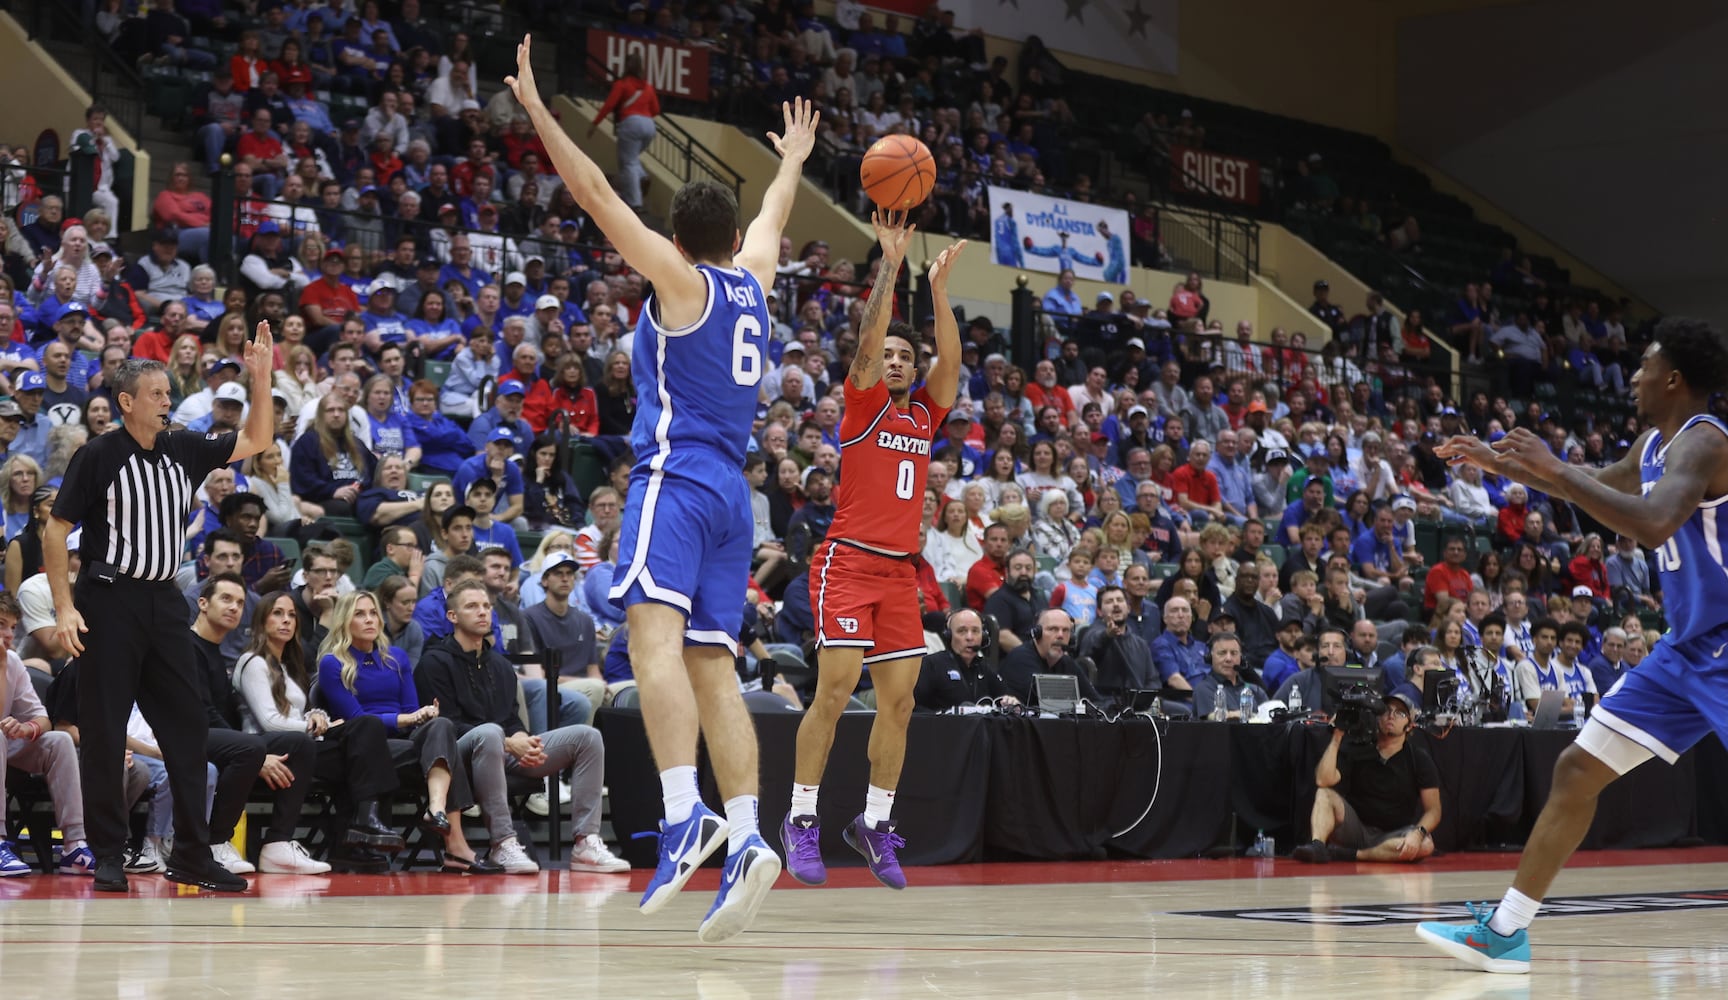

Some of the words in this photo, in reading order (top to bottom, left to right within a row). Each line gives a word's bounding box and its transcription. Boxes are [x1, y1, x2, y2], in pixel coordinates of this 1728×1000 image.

[606, 36, 691, 95] HOME
[1182, 151, 1249, 200] GUEST
[732, 313, 762, 387] 6
[896, 459, 915, 501] 0
[1654, 536, 1682, 573] 10
